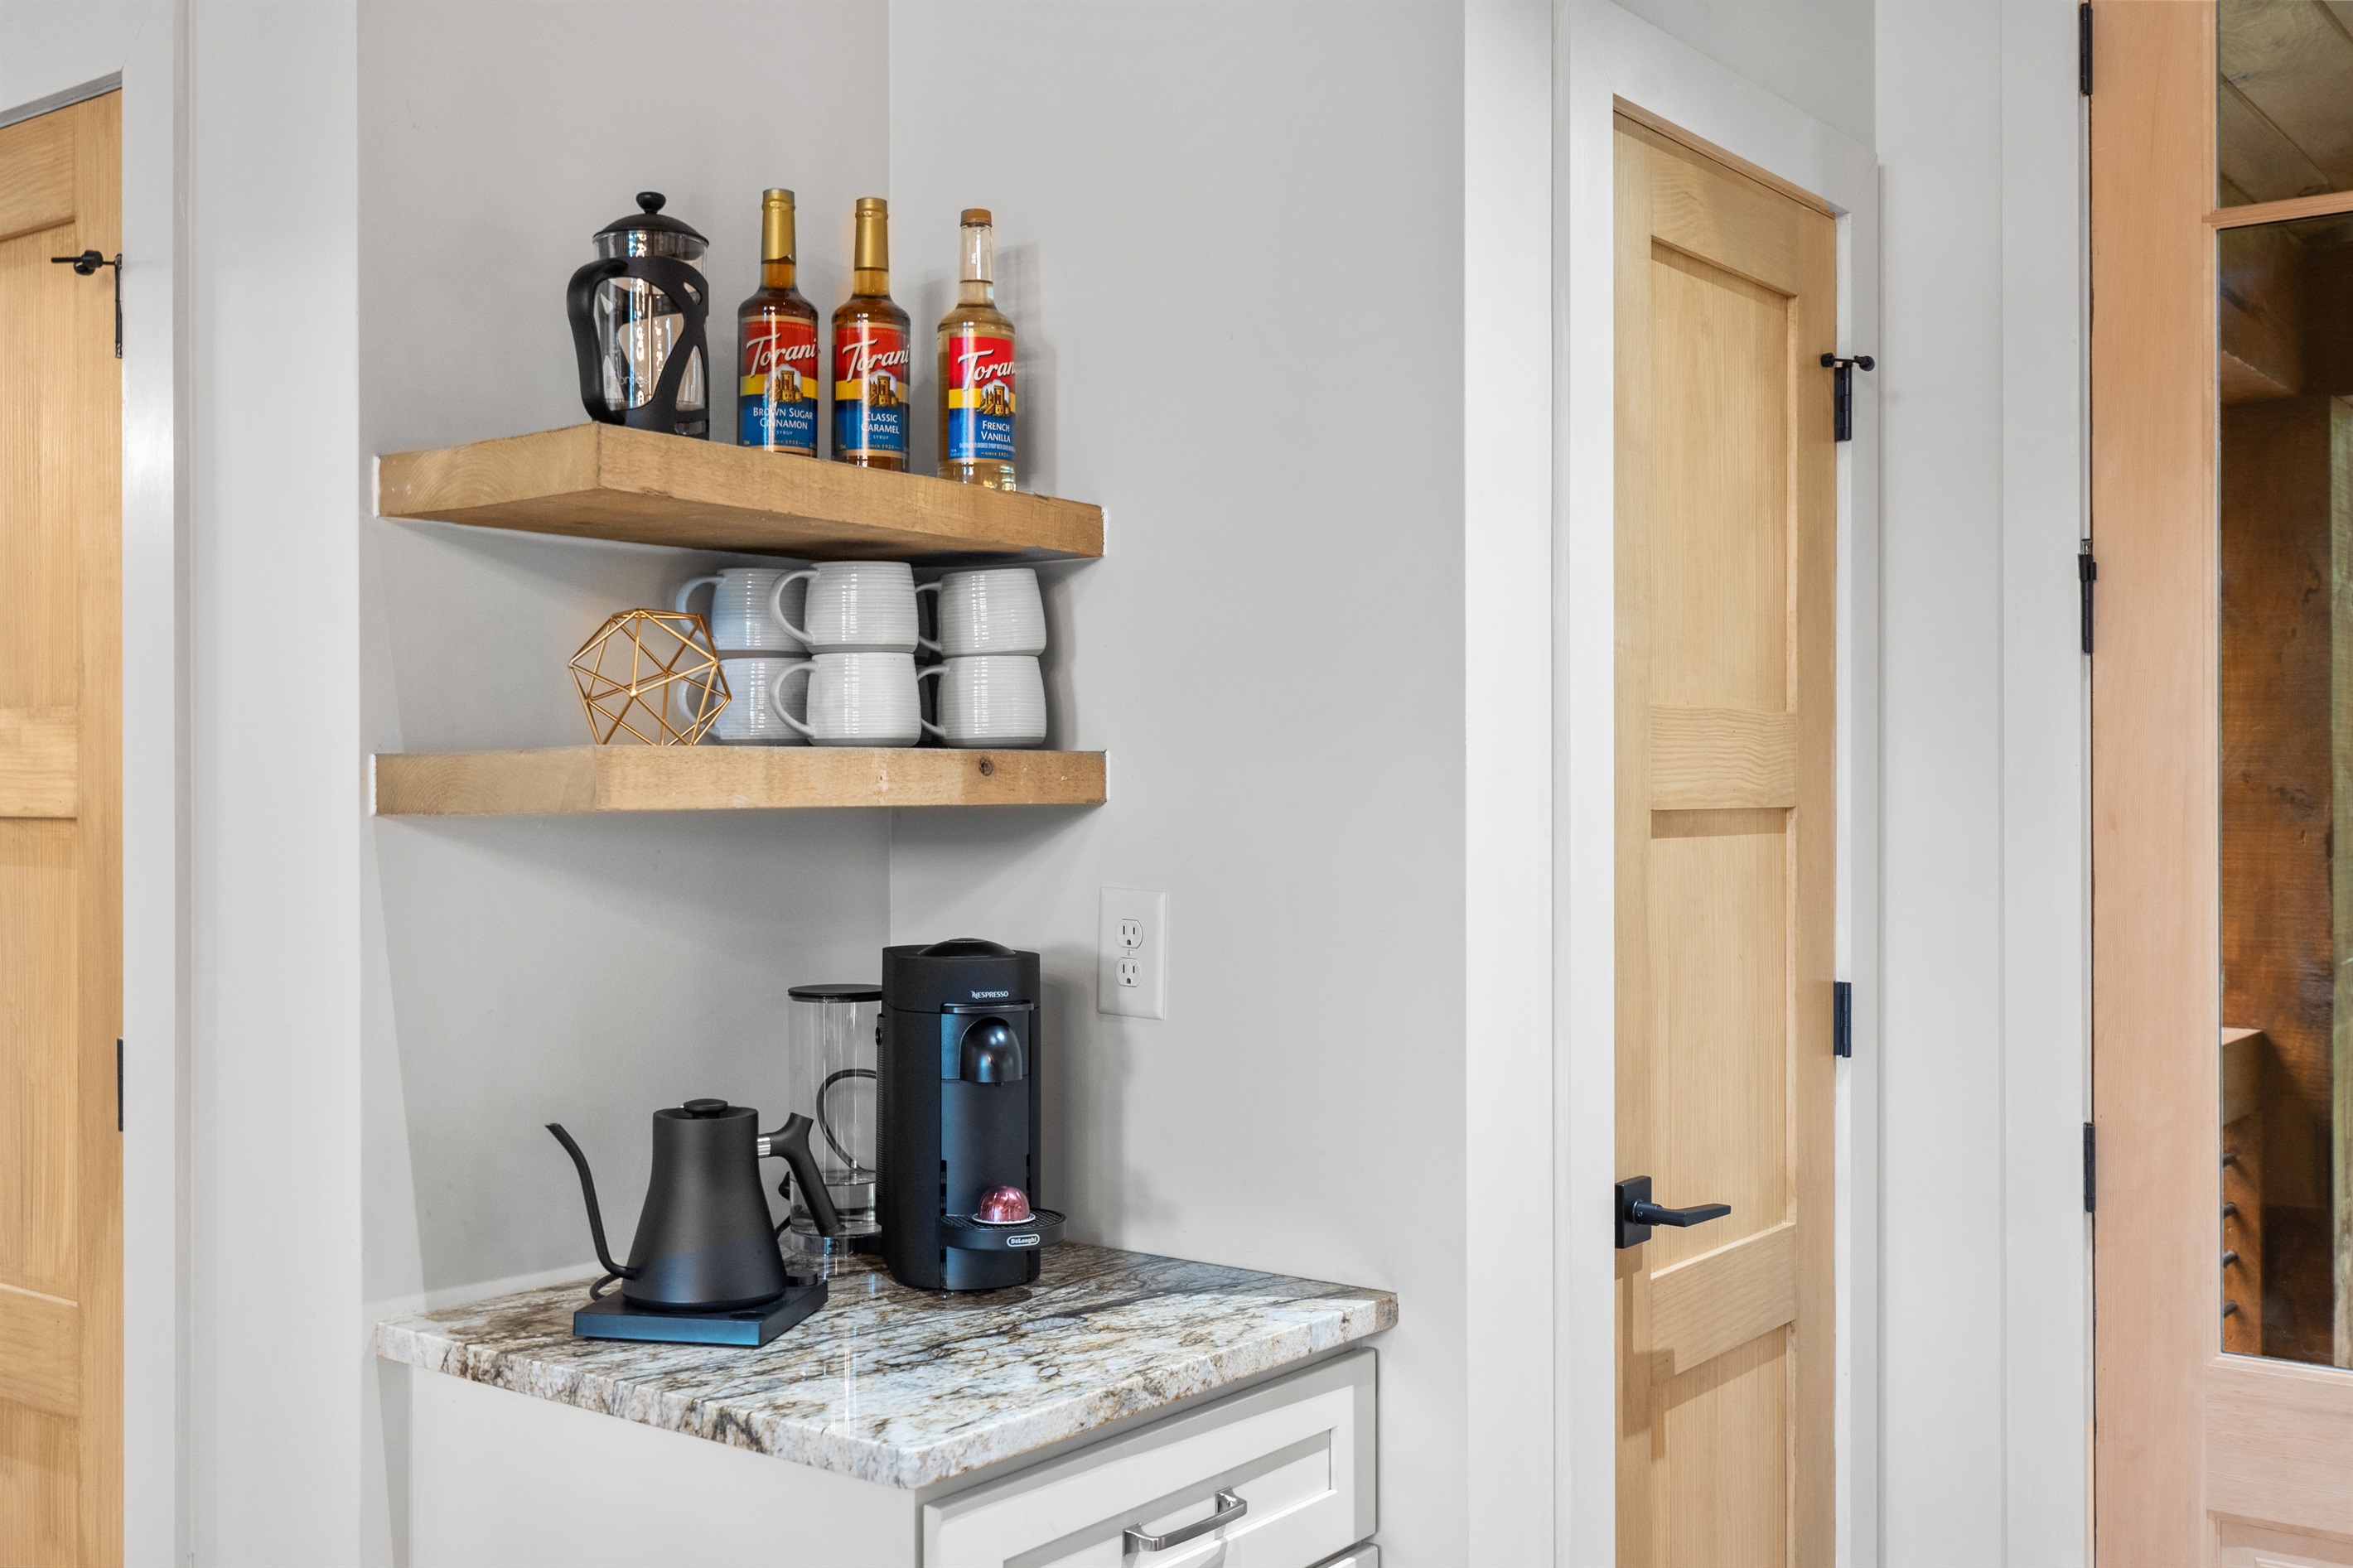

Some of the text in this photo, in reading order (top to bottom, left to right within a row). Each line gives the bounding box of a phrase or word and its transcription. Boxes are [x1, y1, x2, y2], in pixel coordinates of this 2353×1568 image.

[746, 333, 816, 378] Torani
[843, 338, 910, 383] Torani
[958, 349, 1016, 392] Toran
[753, 407, 813, 420] BROWN SUGAR
[865, 412, 897, 422] CLASSIC
[861, 423, 900, 434] CARAMEL
[982, 420, 1010, 432] FRENCH
[980, 431, 1011, 442] VANILLA
[970, 991, 1009, 999] NESPRESSO
